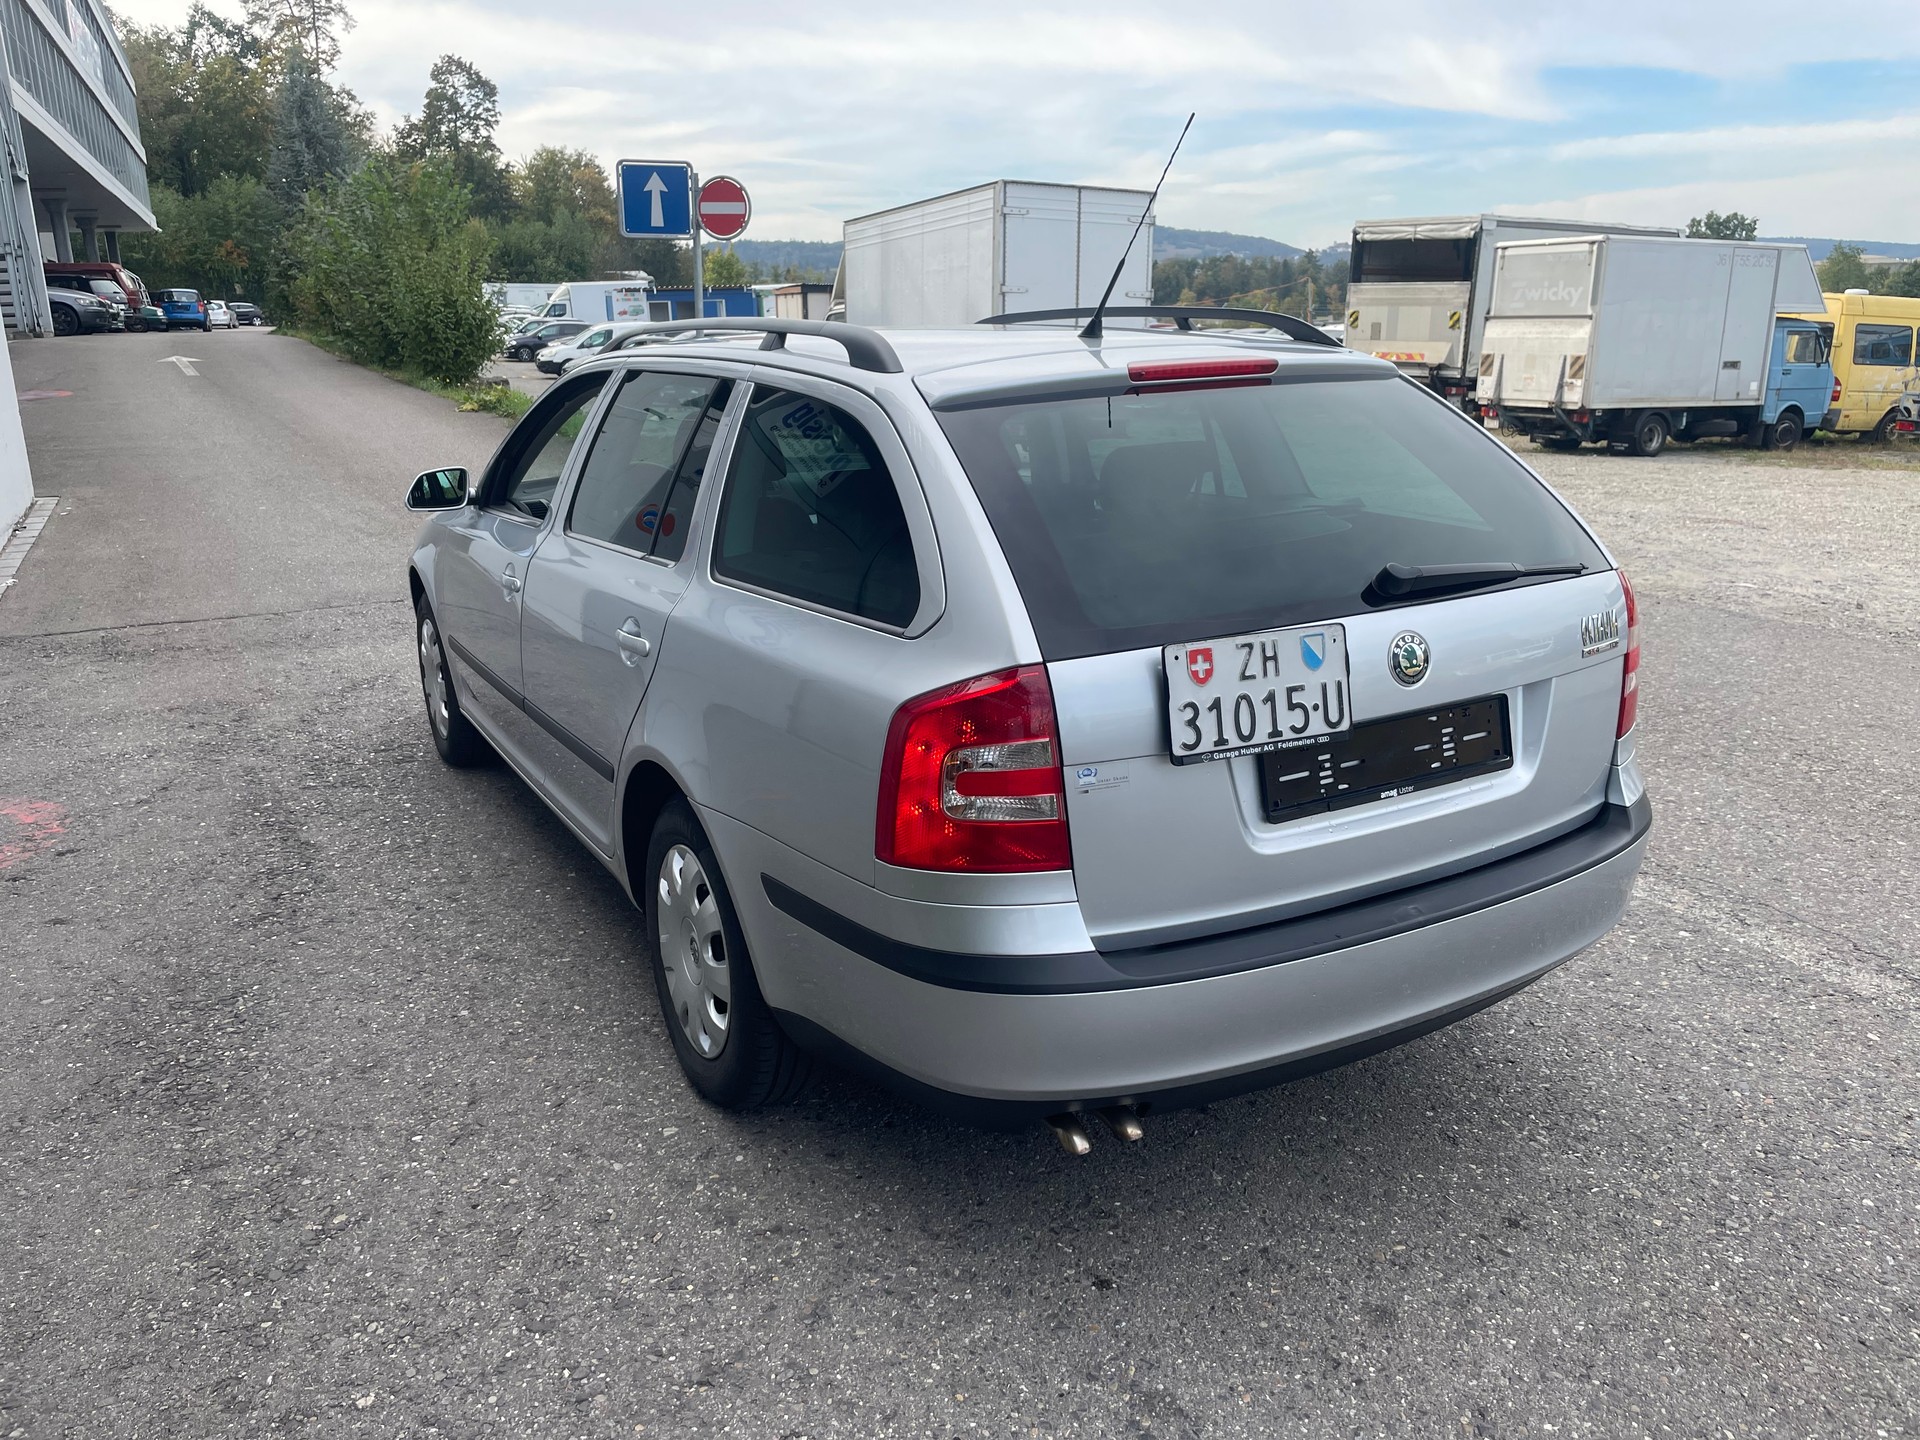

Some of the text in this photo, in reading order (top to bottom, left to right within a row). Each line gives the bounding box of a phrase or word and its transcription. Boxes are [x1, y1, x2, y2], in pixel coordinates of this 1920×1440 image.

[1509, 280, 1584, 308] Zwicky
[1236, 639, 1280, 681] ZH
[1213, 738, 1315, 760] Garage Huber AG Feldmeilen
[1380, 785, 1415, 798] amag Uster
